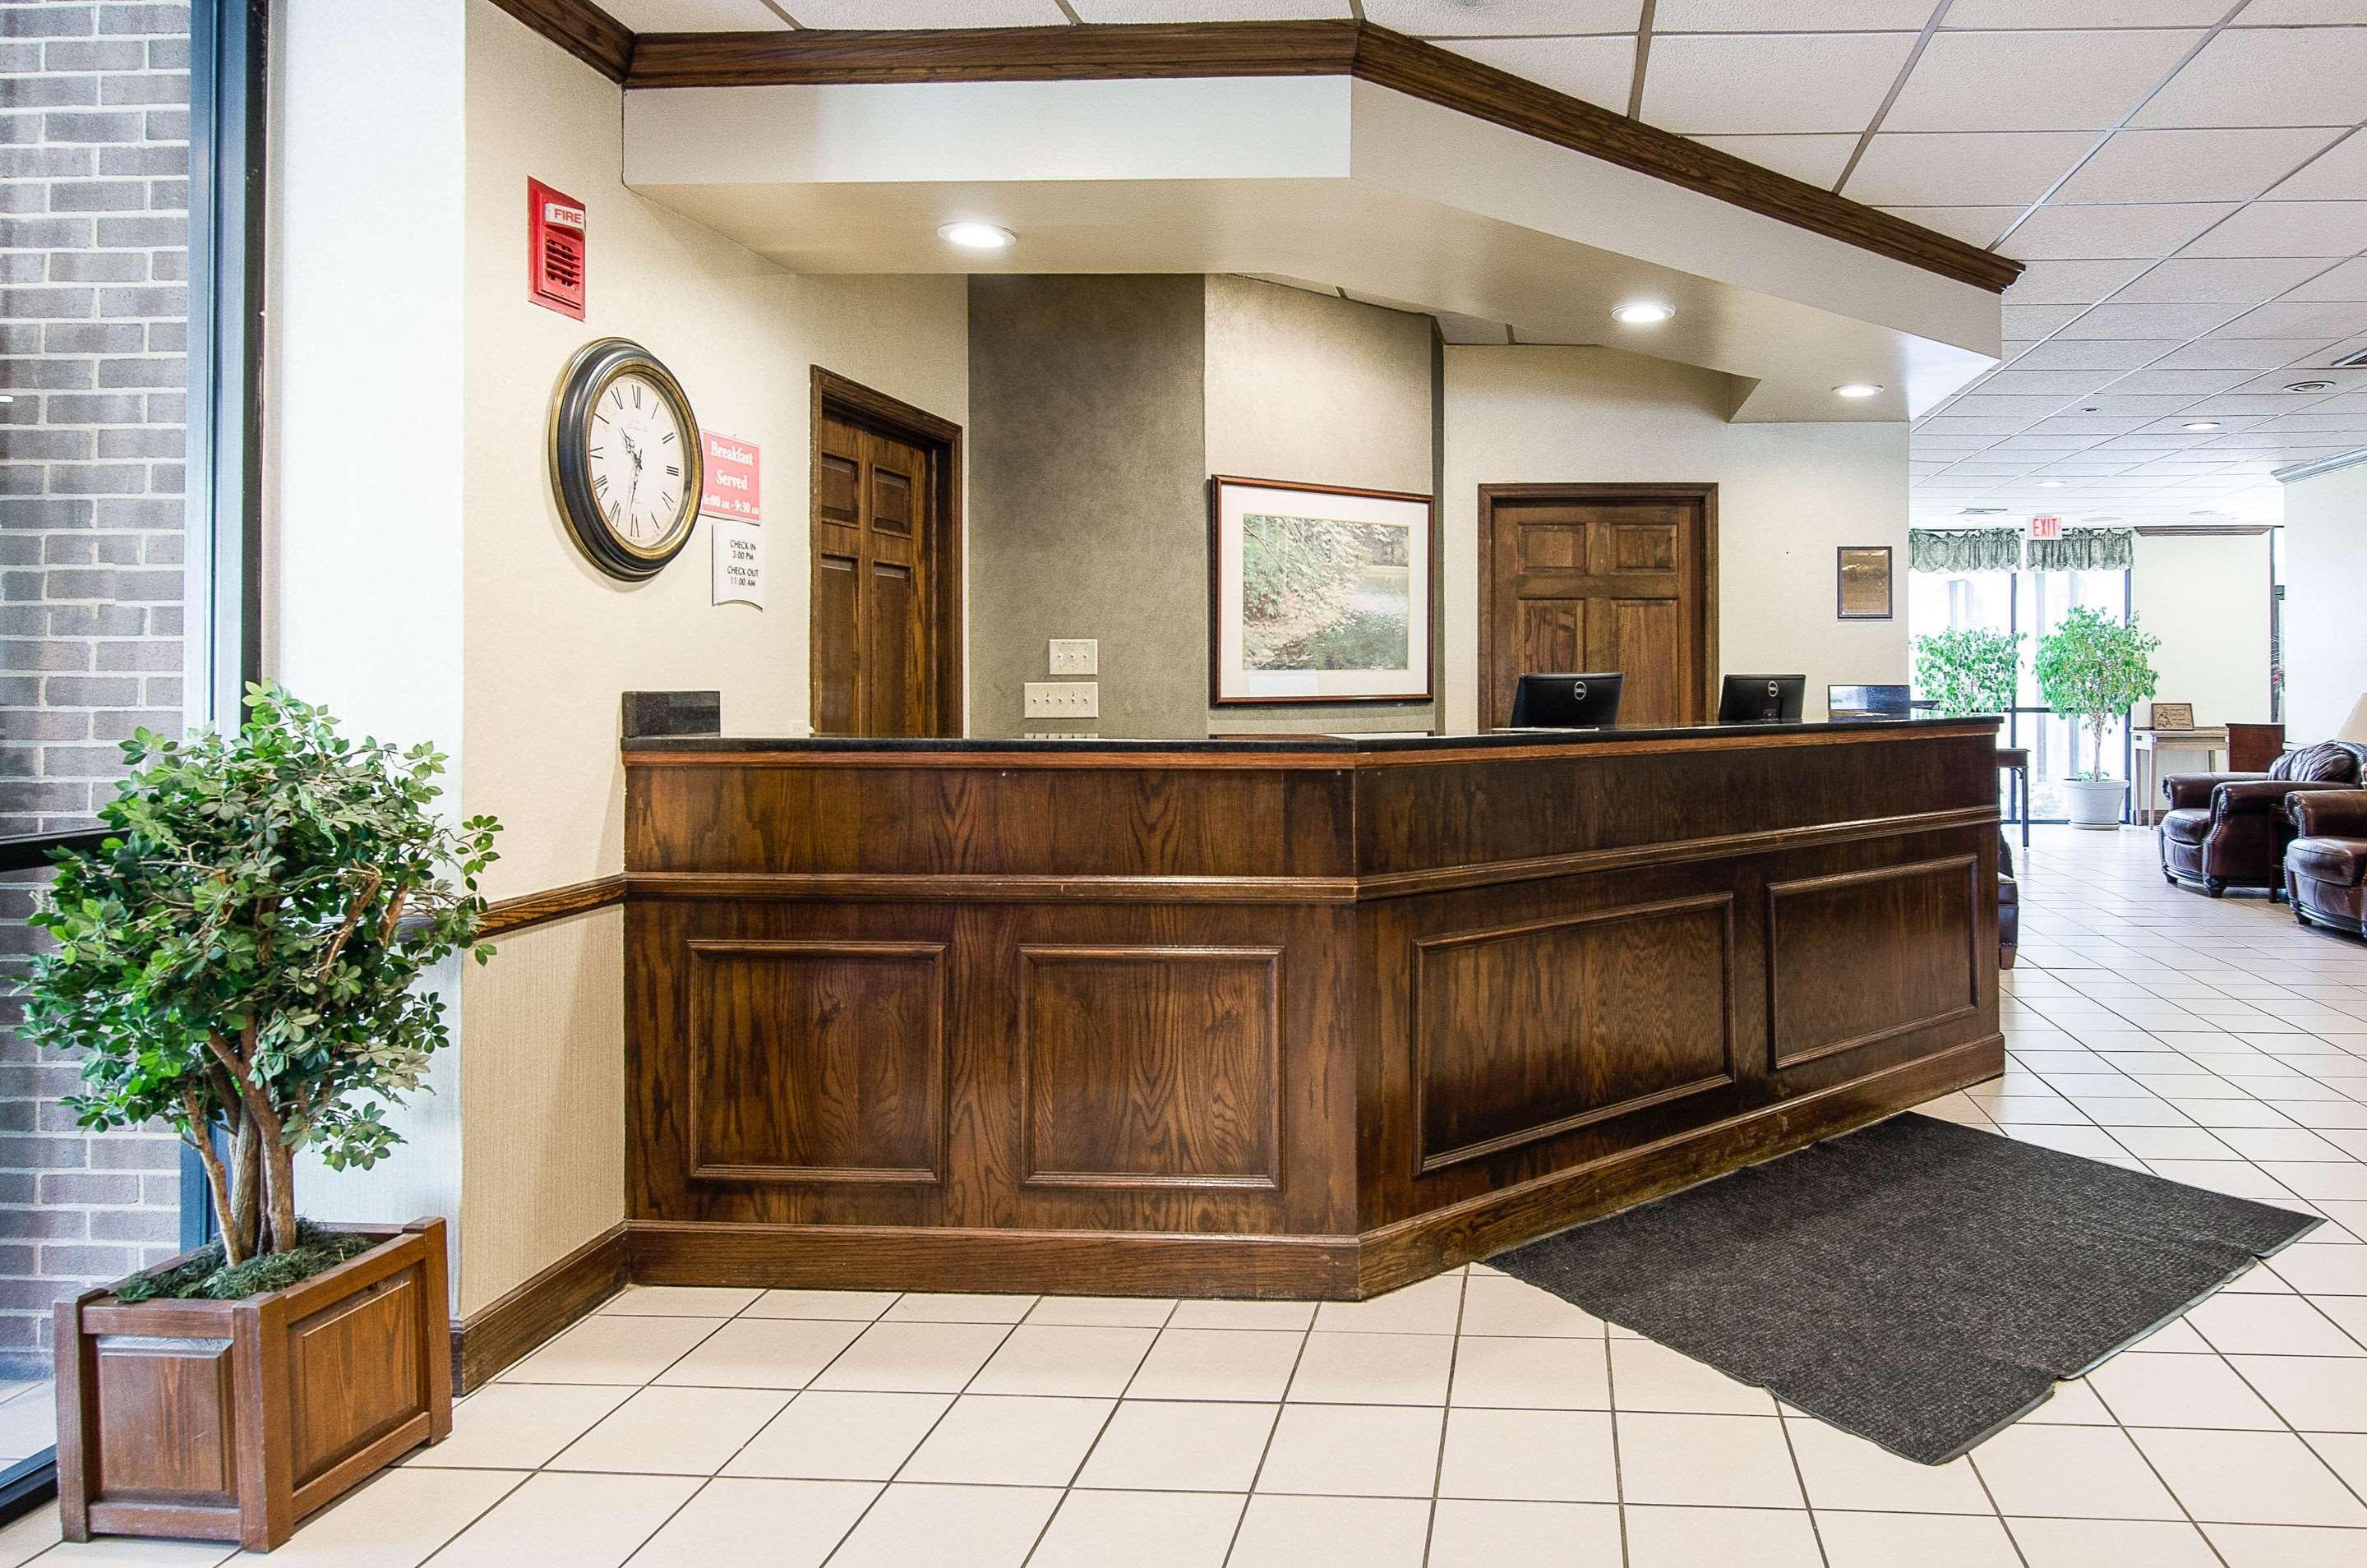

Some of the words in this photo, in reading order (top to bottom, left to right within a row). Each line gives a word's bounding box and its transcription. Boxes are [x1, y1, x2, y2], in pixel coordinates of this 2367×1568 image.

[554, 208, 582, 224] FIRE
[710, 440, 754, 466] Breakfast
[716, 469, 749, 490] Served
[735, 499, 751, 513] 9:30
[2032, 518, 2058, 537] EXIT
[730, 539, 749, 550] CHECK
[750, 542, 756, 551] IN
[745, 551, 754, 560] PM
[727, 565, 745, 575] CHECK
[746, 568, 759, 577] OUT
